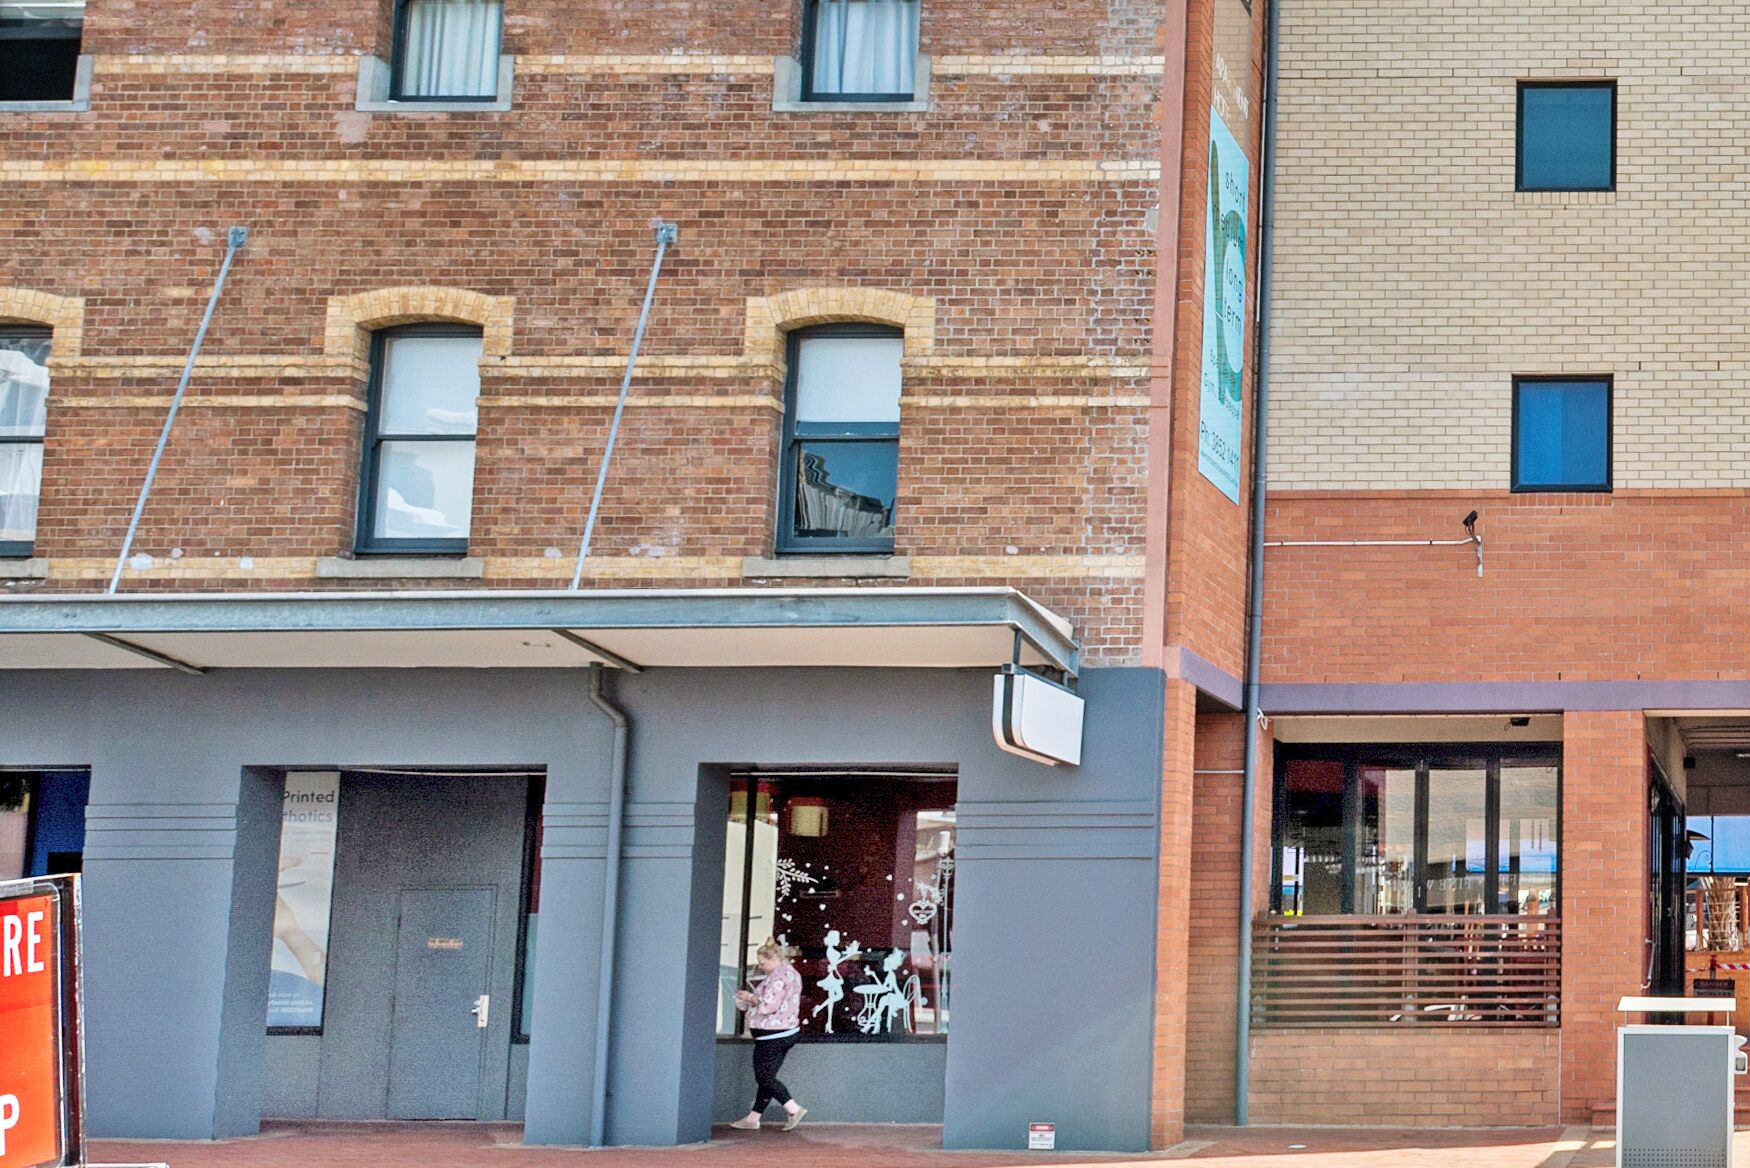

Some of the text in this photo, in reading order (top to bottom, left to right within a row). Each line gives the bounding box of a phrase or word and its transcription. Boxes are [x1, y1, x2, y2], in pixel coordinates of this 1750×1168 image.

[1226, 257, 1242, 304] long
[1225, 296, 1241, 336] term
[281, 790, 335, 803] Printed
[3, 910, 45, 977] RE
